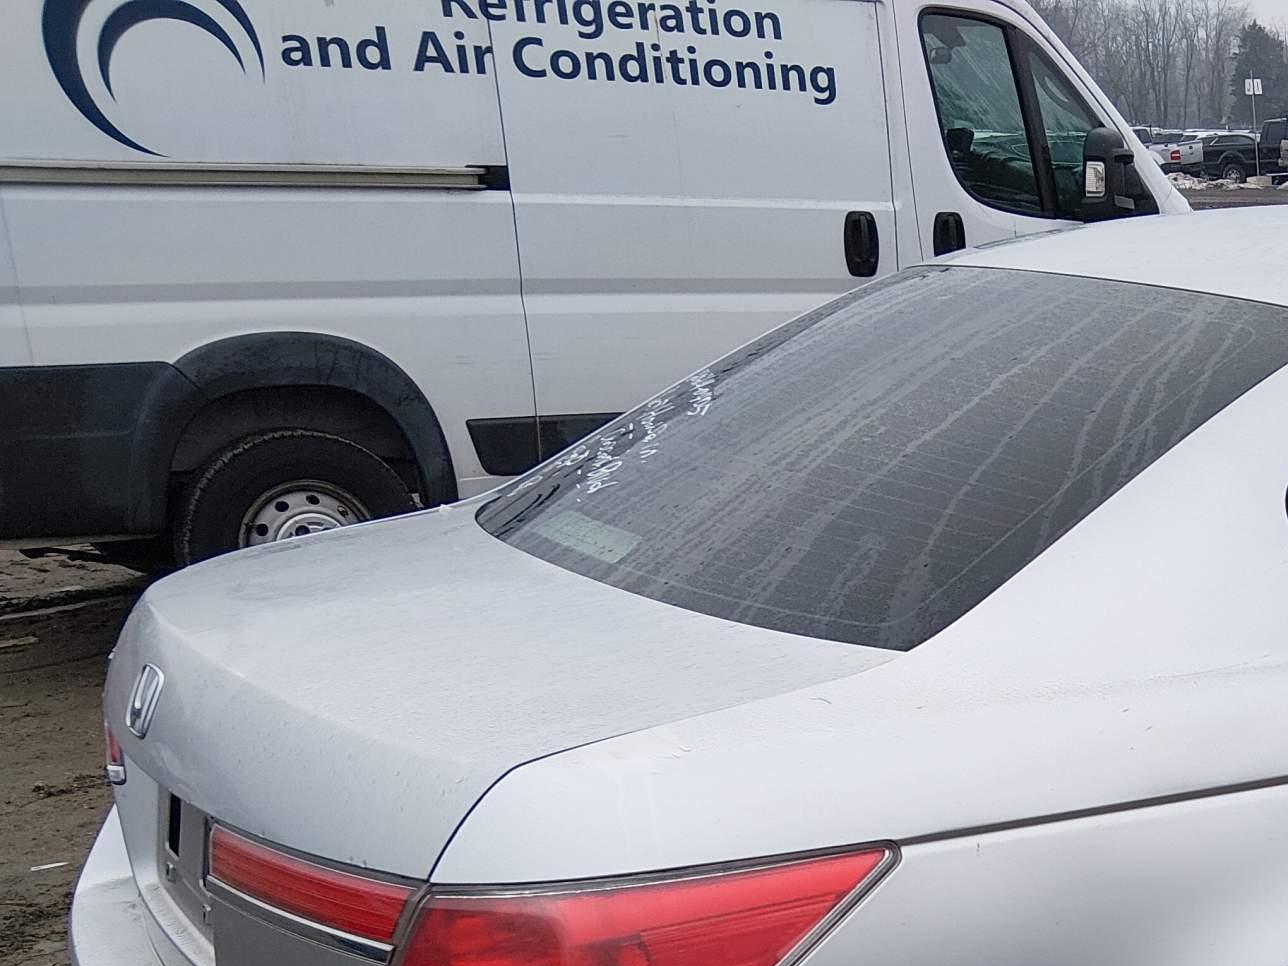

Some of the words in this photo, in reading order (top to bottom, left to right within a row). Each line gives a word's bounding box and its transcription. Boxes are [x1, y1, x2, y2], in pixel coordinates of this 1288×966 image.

[281, 26, 392, 70] and
[413, 31, 493, 75] Air
[512, 36, 837, 105] Conditioning
